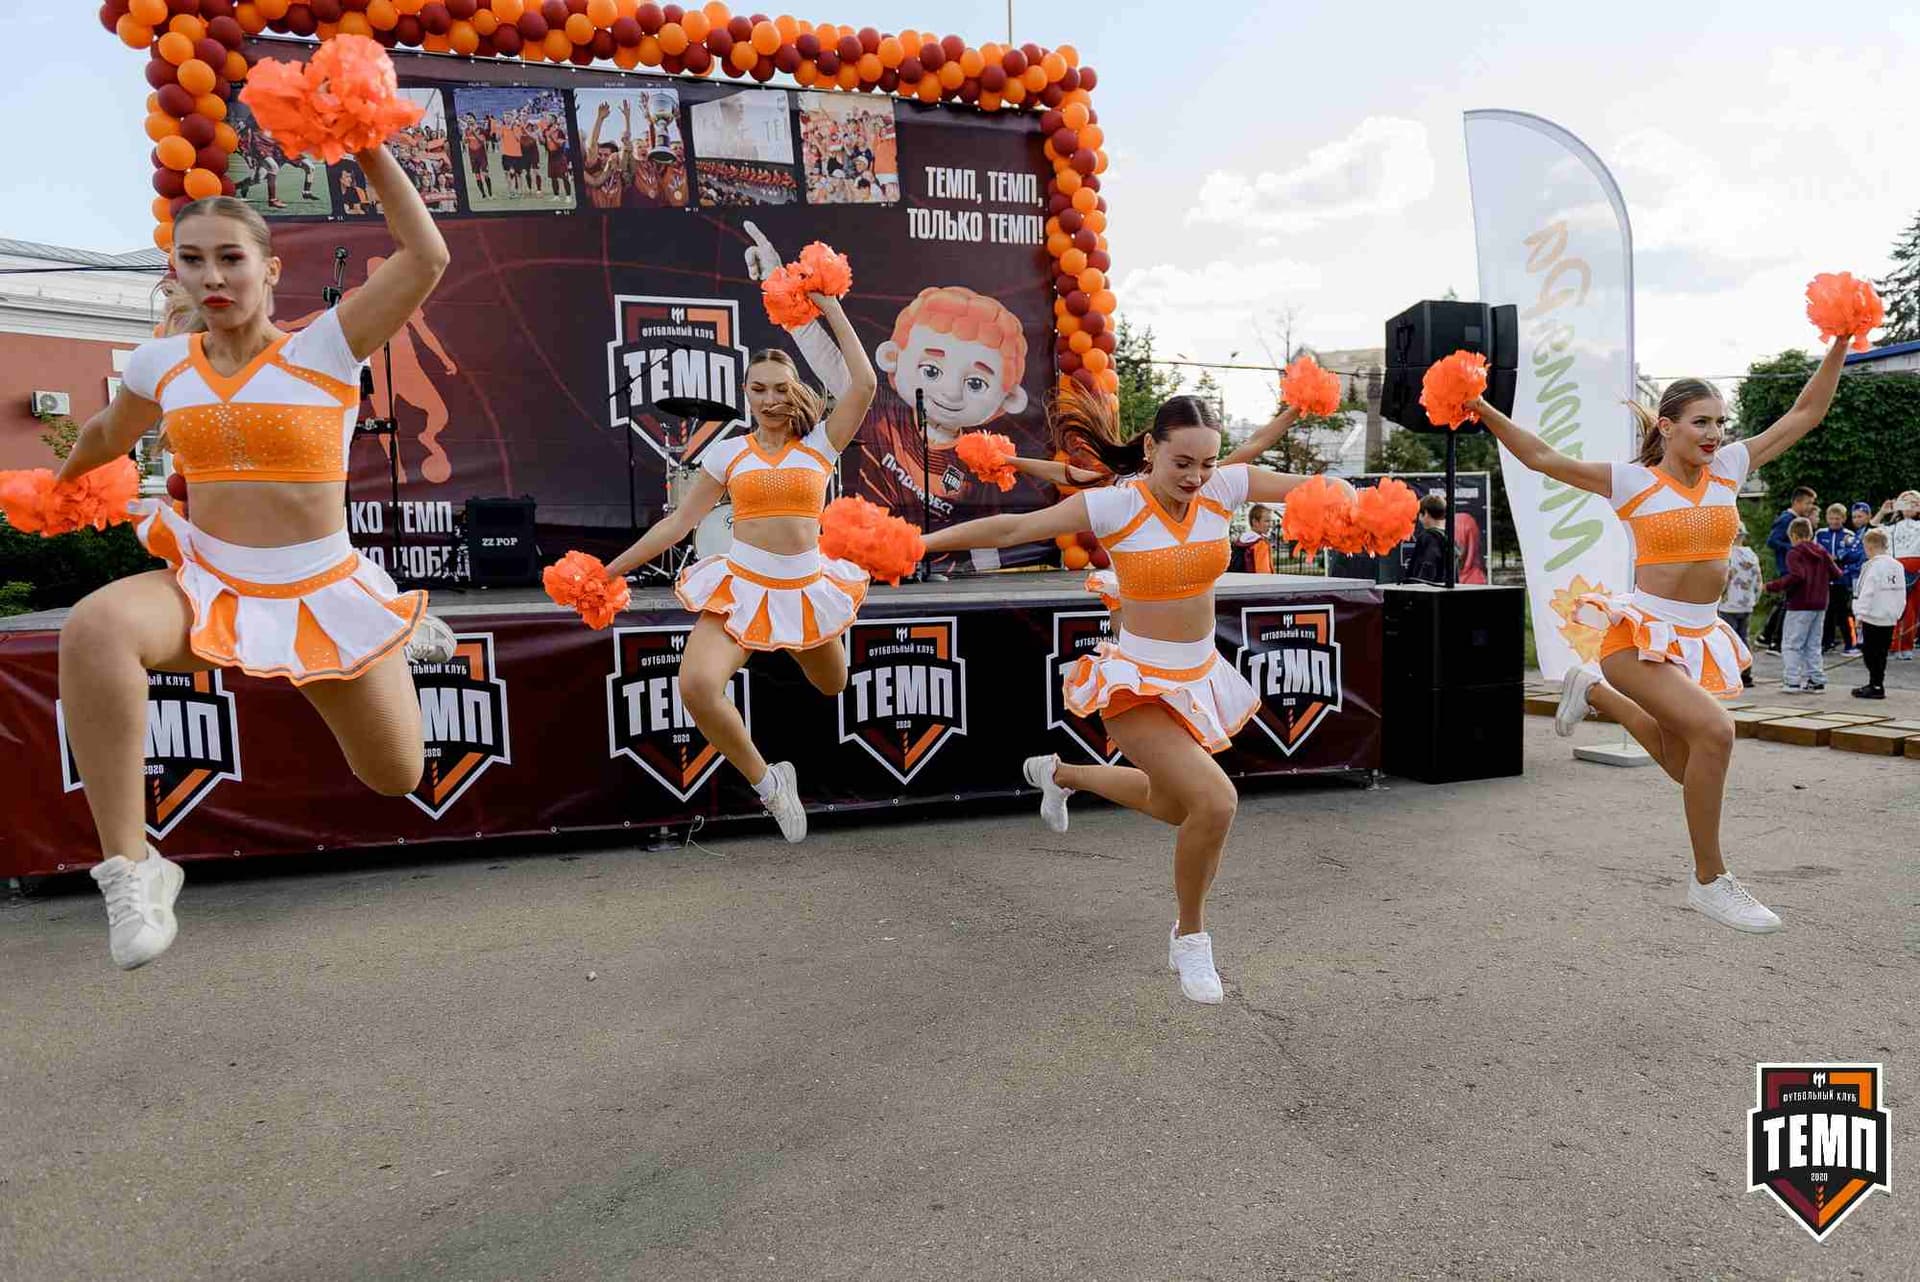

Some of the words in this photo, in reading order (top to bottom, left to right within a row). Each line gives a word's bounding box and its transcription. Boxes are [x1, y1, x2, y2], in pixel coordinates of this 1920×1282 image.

[925, 166, 982, 204] ТЕМП,
[987, 171, 1044, 207] ТЕМП,
[907, 208, 983, 242] ТОЛЬКО
[988, 213, 1044, 245] ТЕМП!
[695, 329, 715, 339] КЛУБ
[623, 348, 737, 409] ТЕМП
[389, 501, 452, 534] ЕМП
[496, 537, 518, 546] POP
[445, 663, 467, 675] КЛУБ
[641, 654, 684, 667] ФУТБОЛЬН
[1248, 648, 1332, 701] ТЕМП
[166, 675, 190, 687] КЛУБ
[851, 665, 953, 723] ТЕМП
[143, 700, 222, 761] МП
[419, 687, 493, 745] МП
